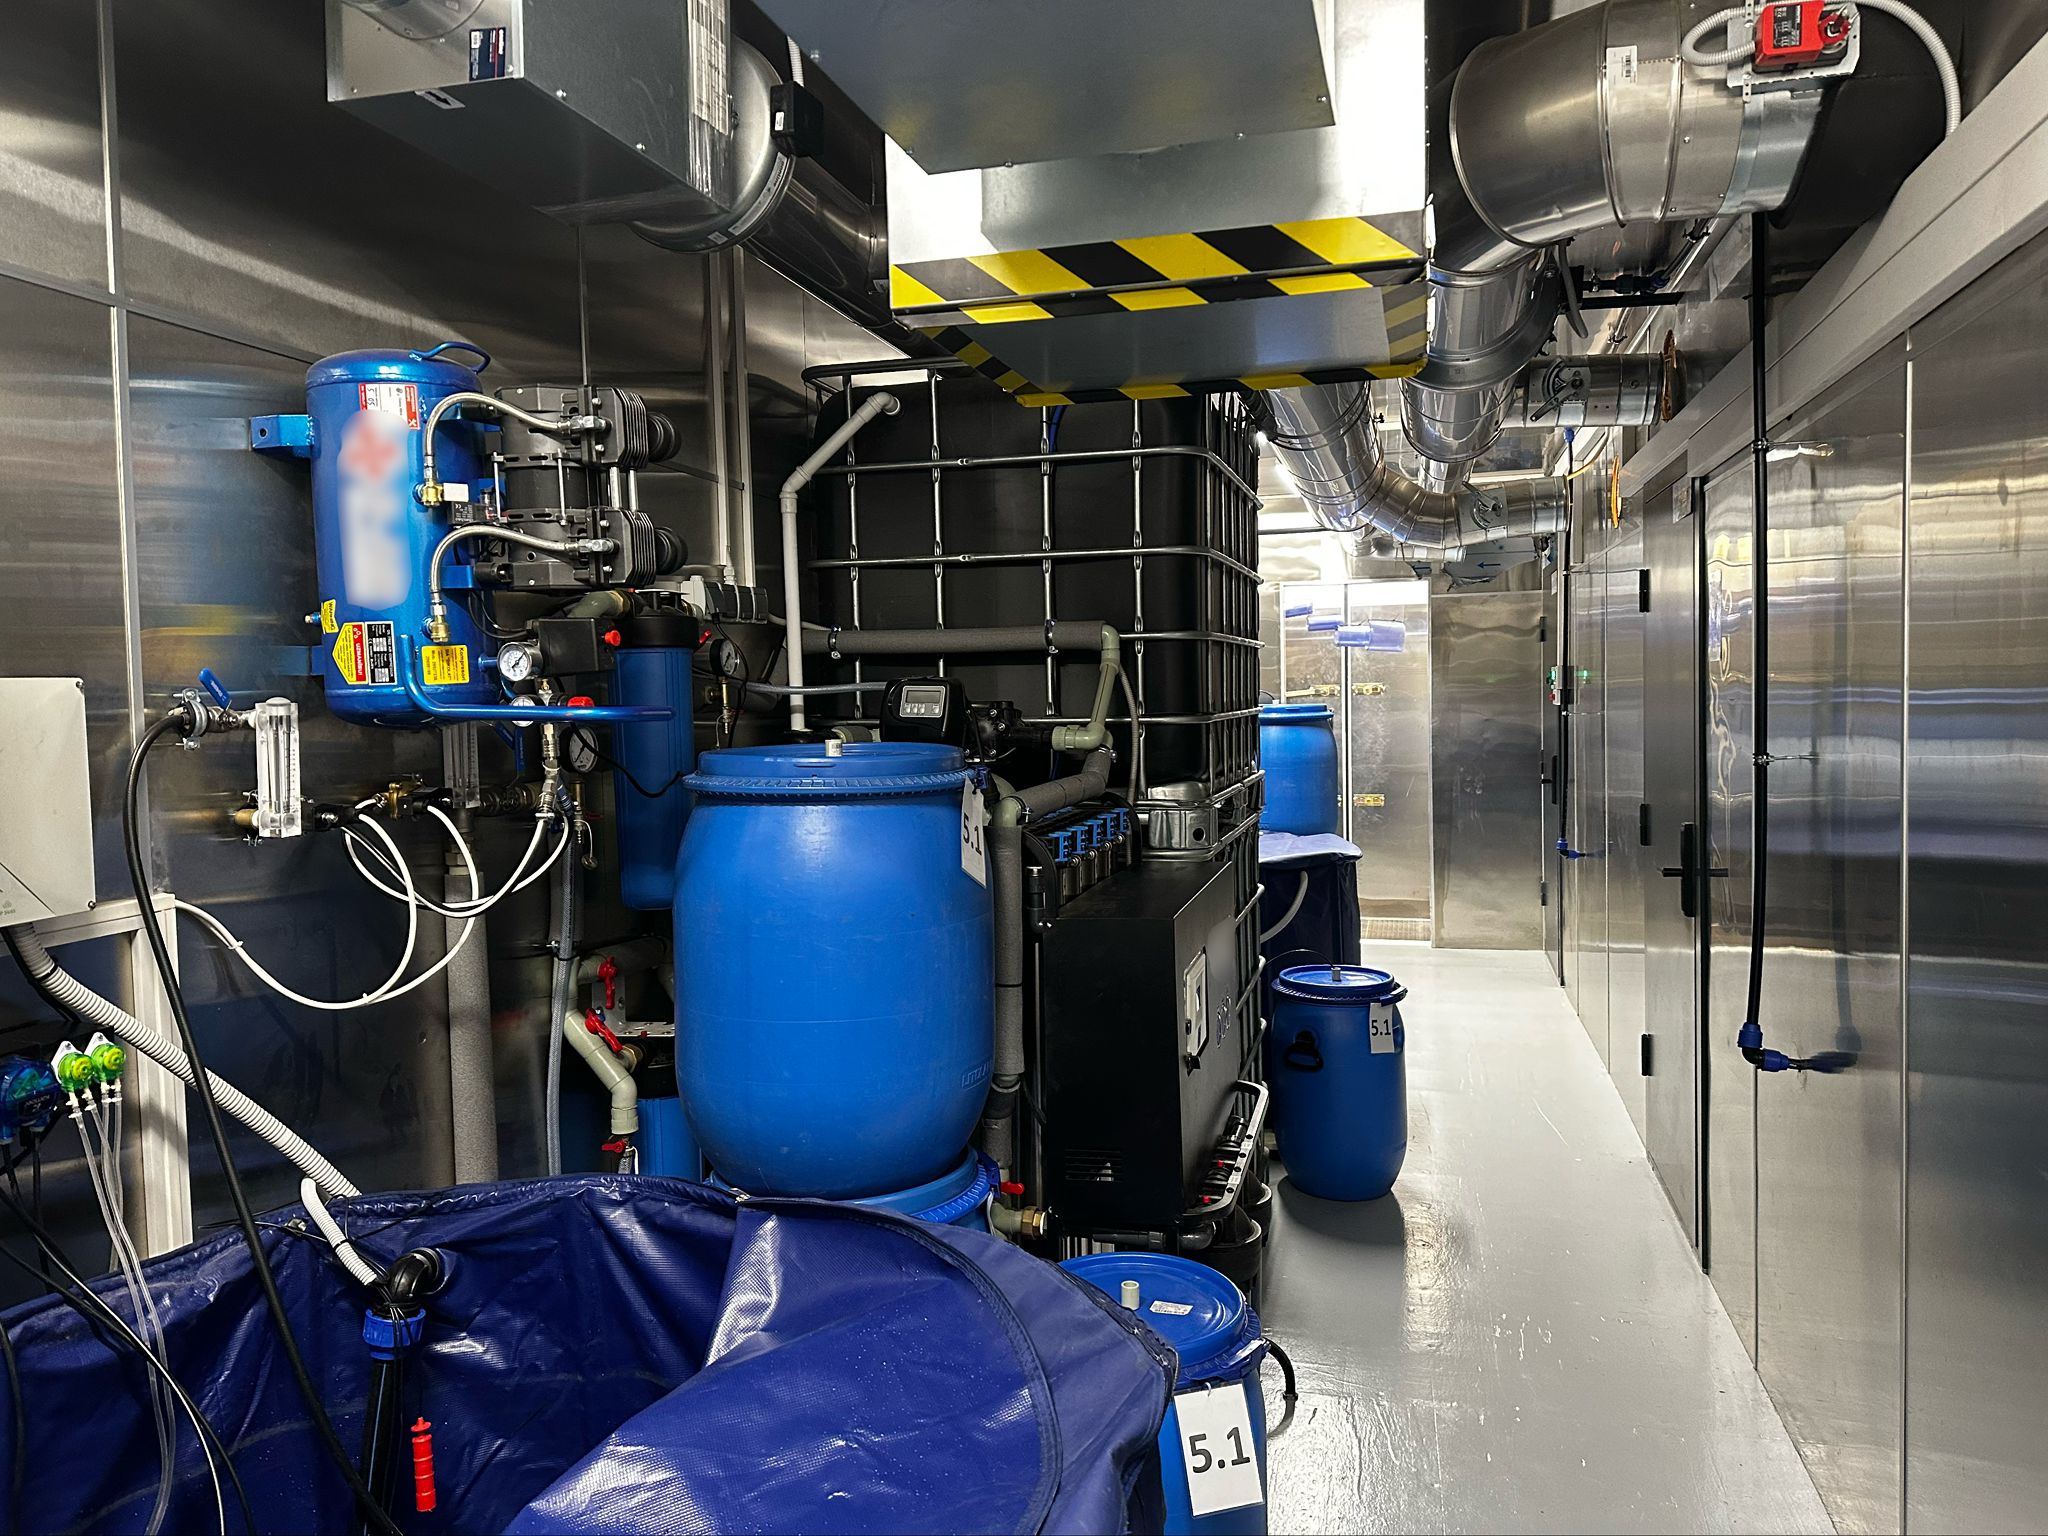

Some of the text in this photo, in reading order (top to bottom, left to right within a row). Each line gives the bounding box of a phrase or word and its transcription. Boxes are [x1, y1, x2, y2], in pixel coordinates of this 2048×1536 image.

[963, 812, 982, 856] 5.1
[1371, 1019, 1391, 1036] 5.1
[1189, 1426, 1250, 1473] 5.1
